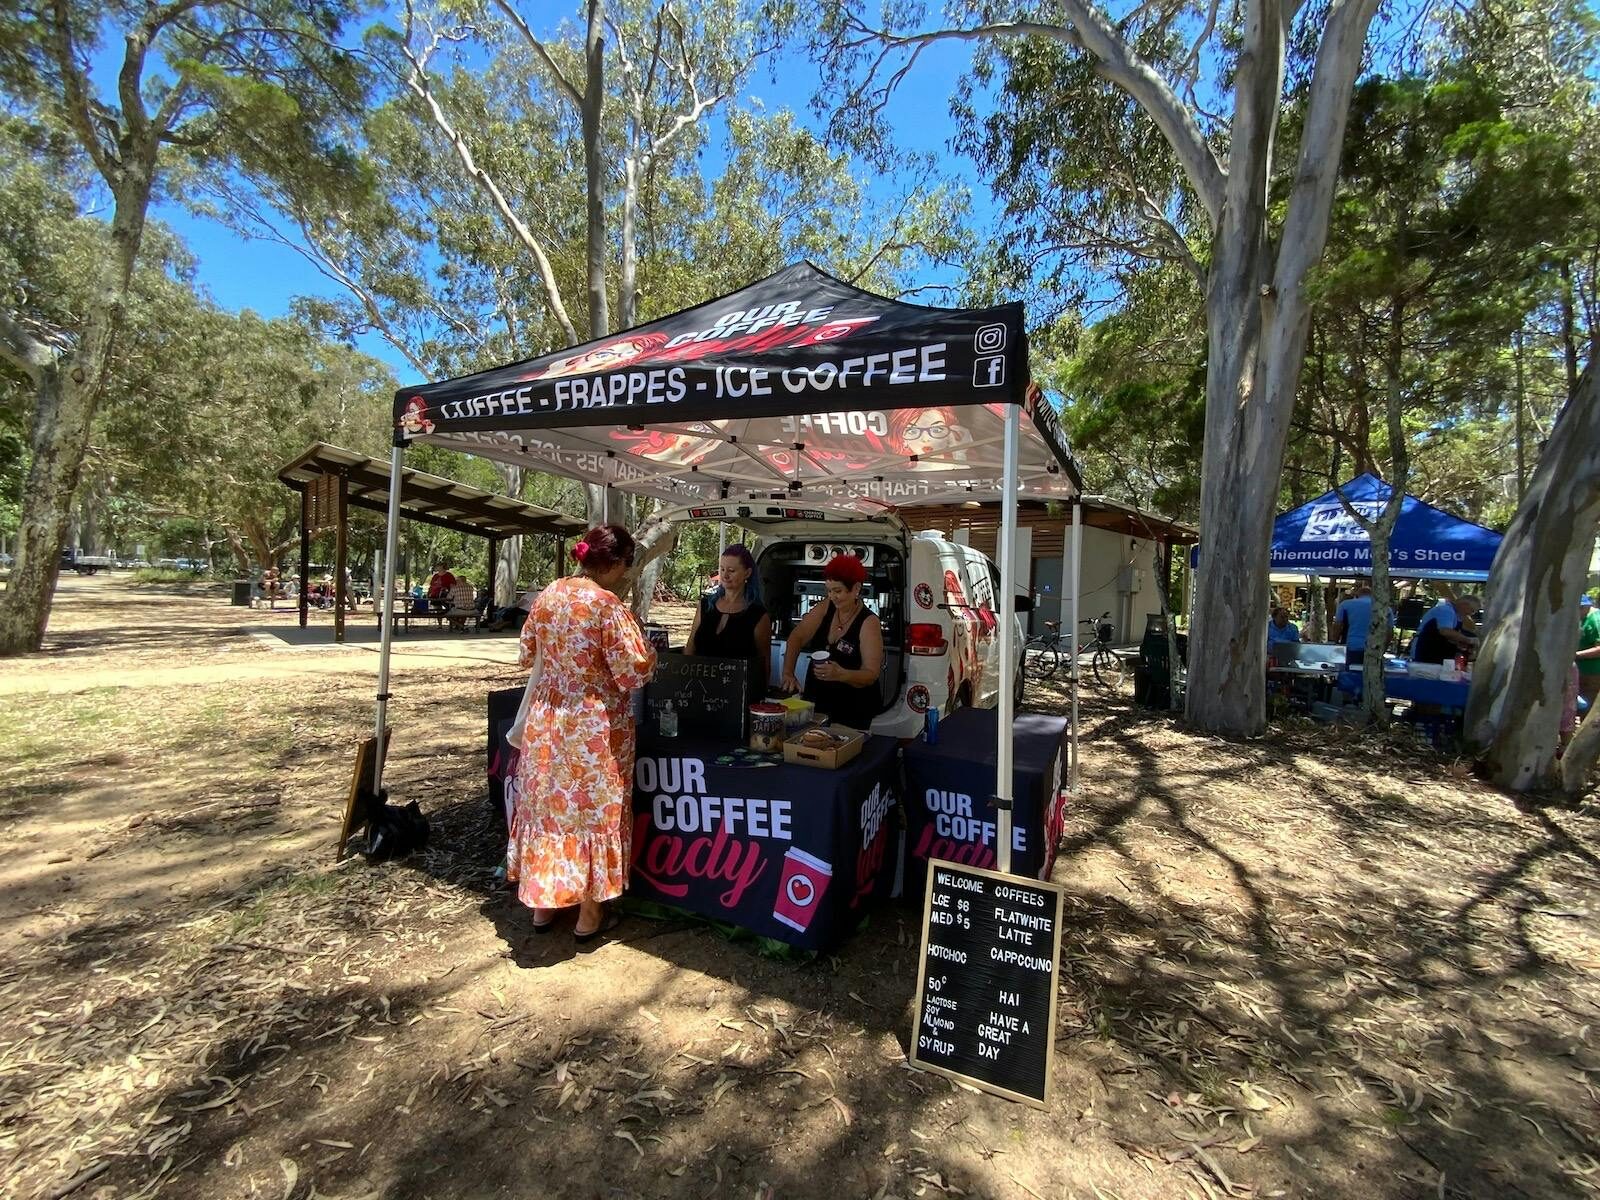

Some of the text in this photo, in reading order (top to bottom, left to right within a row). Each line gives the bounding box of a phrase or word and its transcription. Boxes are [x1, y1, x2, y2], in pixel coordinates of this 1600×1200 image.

[714, 301, 802, 328] OUR
[664, 306, 834, 348] COFFEE
[554, 367, 686, 411] FRAPPES
[715, 366, 773, 399] ICE
[782, 343, 947, 394] COFFEE
[1310, 524, 1366, 536] She
[1269, 548, 1350, 561] hiemudlo
[1414, 548, 1466, 562] Shed
[636, 757, 708, 794] OUR
[861, 781, 880, 829] OUR
[925, 788, 973, 818] OUR
[653, 795, 792, 841] COFFEE
[936, 814, 1027, 851] COFFE
[937, 872, 1045, 907] WELCOME COFFEES
[932, 893, 970, 912] LGE $6
[930, 911, 953, 925] MED
[994, 907, 1052, 932] FLATWHITE
[998, 926, 1033, 945] LATTE
[927, 943, 1052, 972] HOTCHOC CAPPCCUNO
[926, 994, 957, 1010] LACTOSE
[999, 990, 1020, 1006] HAI
[926, 1004, 940, 1016] SOY
[923, 1012, 955, 1031] ALMOND
[932, 1026, 938, 1036] &
[989, 1011, 1030, 1035] HAVE A
[977, 1024, 1011, 1045] GREAT
[919, 1035, 955, 1057] SYRUP
[977, 1042, 1000, 1060] DAY
